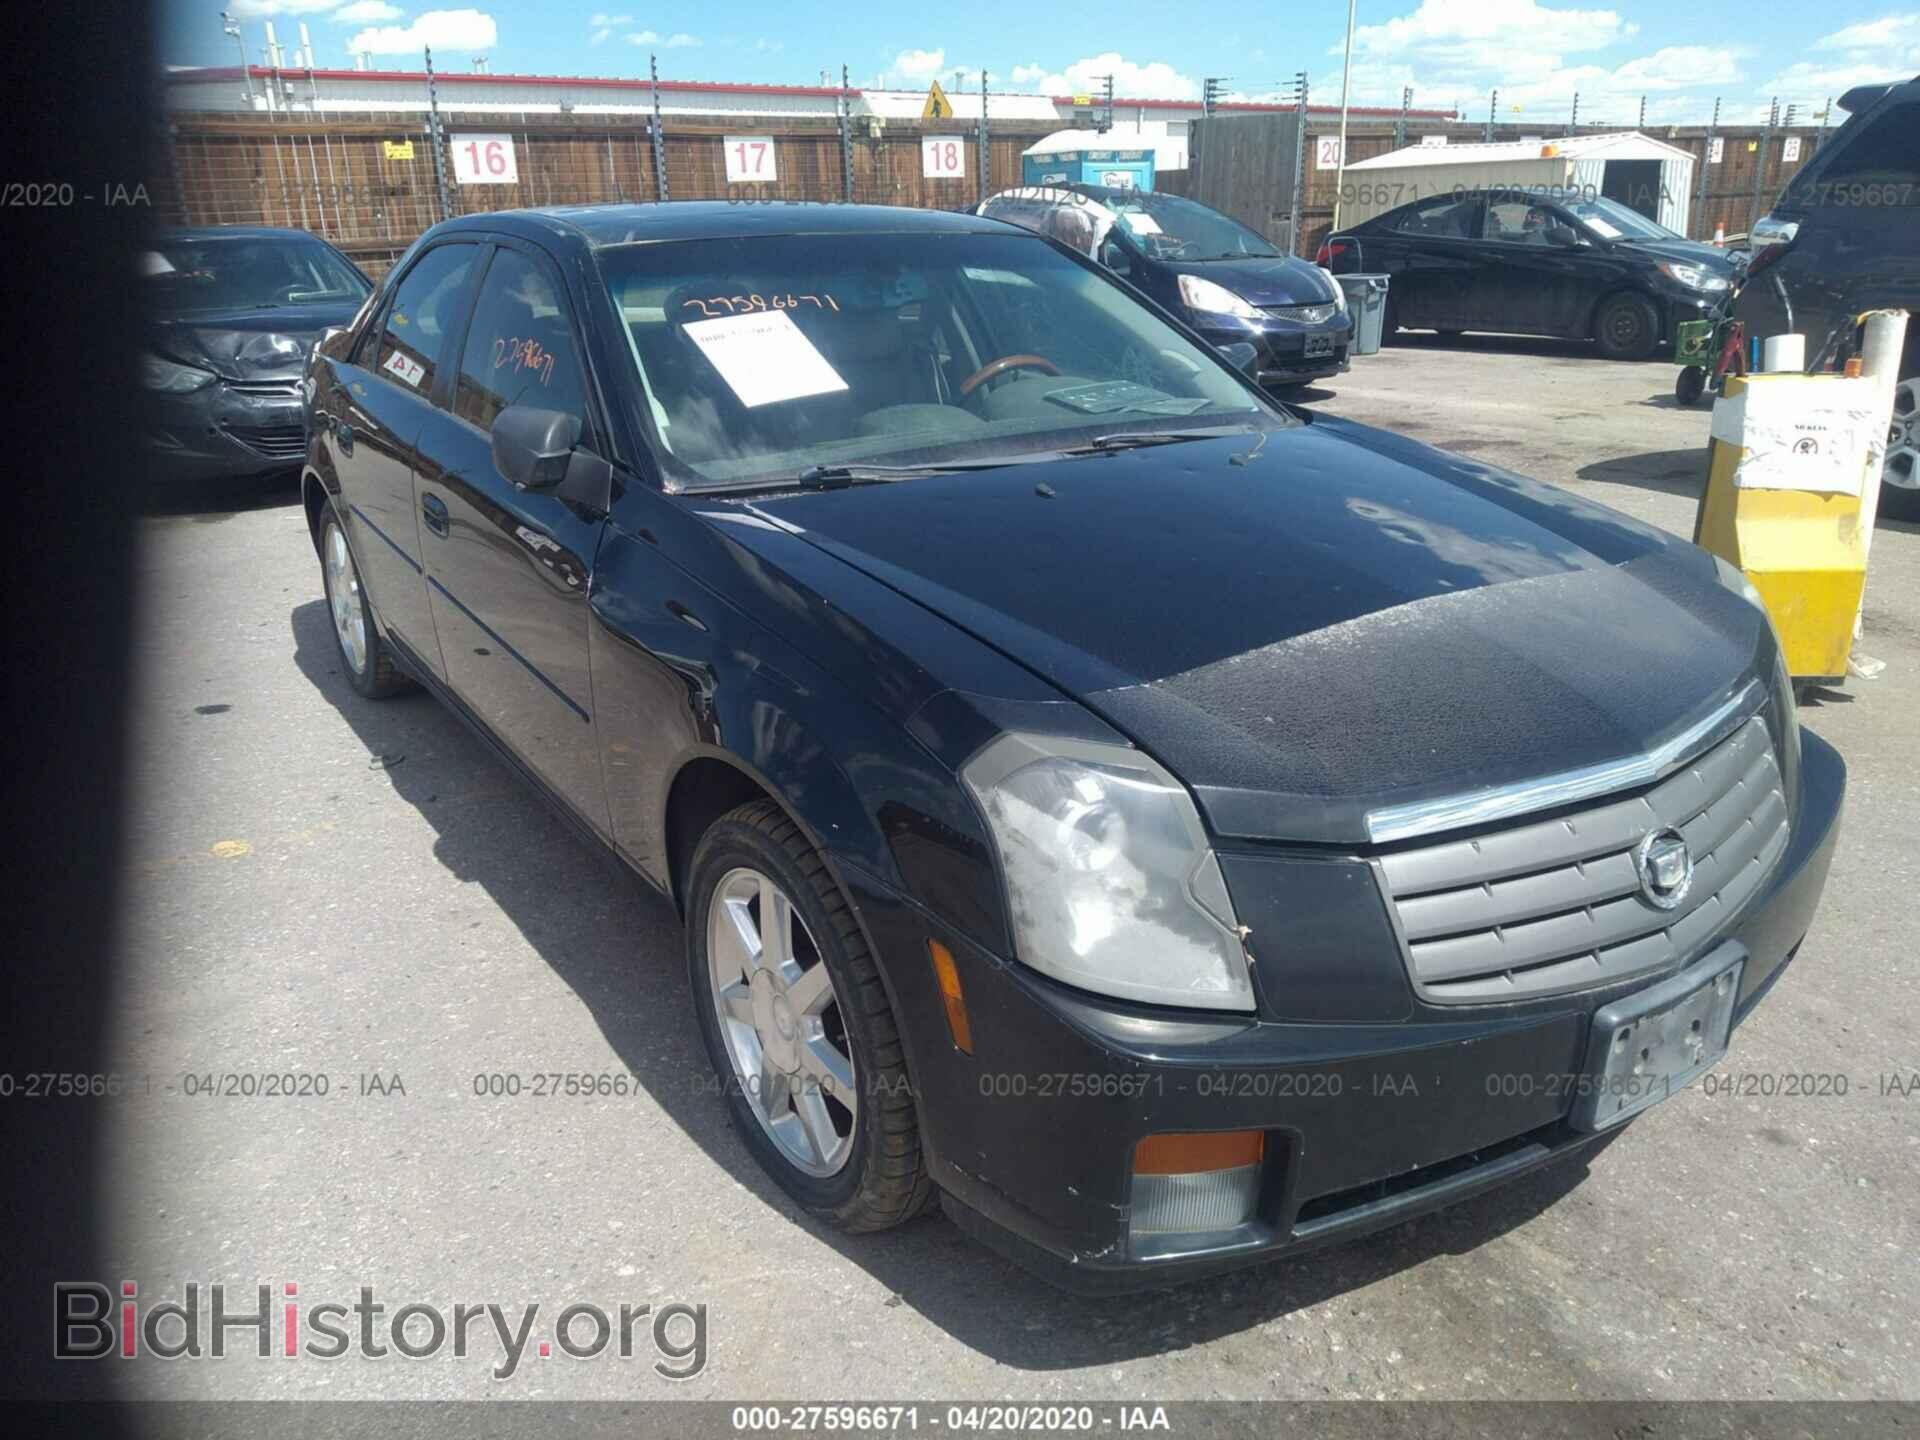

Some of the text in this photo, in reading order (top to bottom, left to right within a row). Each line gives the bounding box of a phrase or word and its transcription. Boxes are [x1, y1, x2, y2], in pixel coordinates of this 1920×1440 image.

[465, 141, 506, 175] 16
[735, 142, 767, 174] 17
[932, 142, 958, 171] 18
[1322, 141, 1339, 164] 20
[683, 294, 840, 316] 27596671
